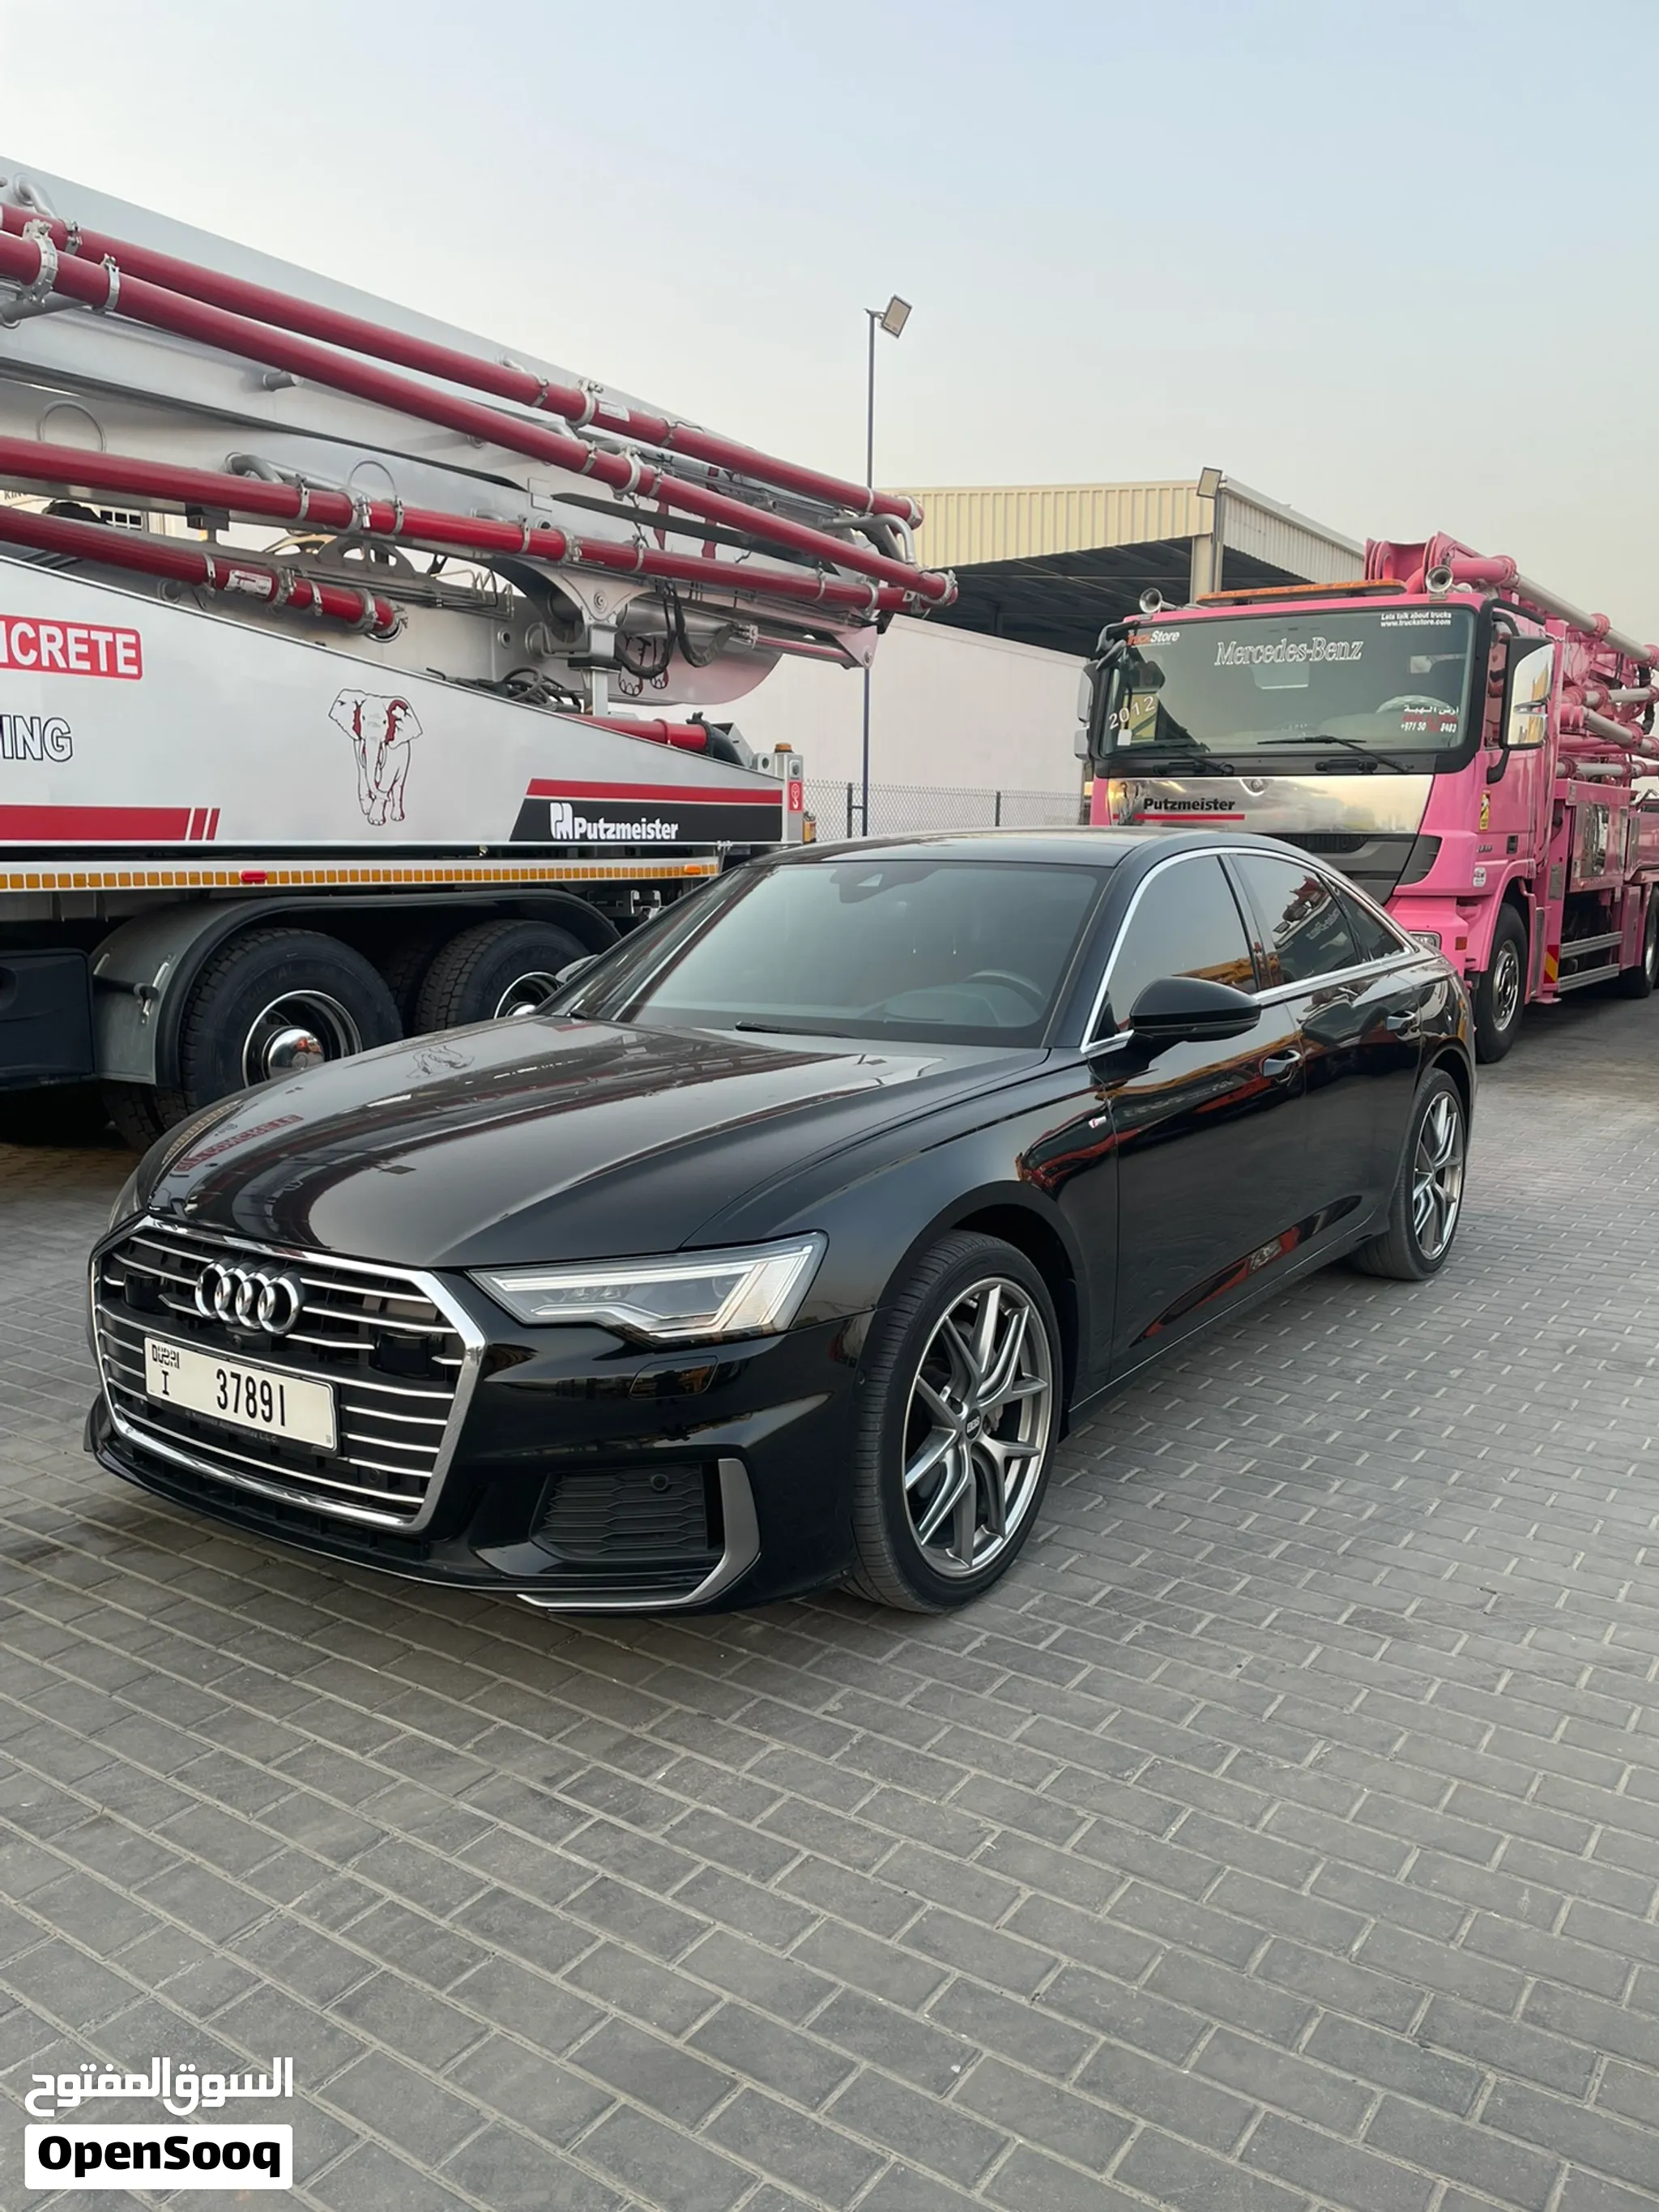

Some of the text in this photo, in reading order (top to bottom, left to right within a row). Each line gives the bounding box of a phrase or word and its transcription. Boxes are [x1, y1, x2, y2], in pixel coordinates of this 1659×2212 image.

[1380, 619, 1452, 627] www.truckstore.com
[1430, 611, 1452, 619] trucks
[1213, 637, 1364, 667] Mercedes-Benz
[1108, 696, 1156, 731] 2012
[1143, 798, 1236, 811] Putzmeister
[574, 817, 679, 840] Putzmeister
[216, 1368, 286, 1427] 37891
